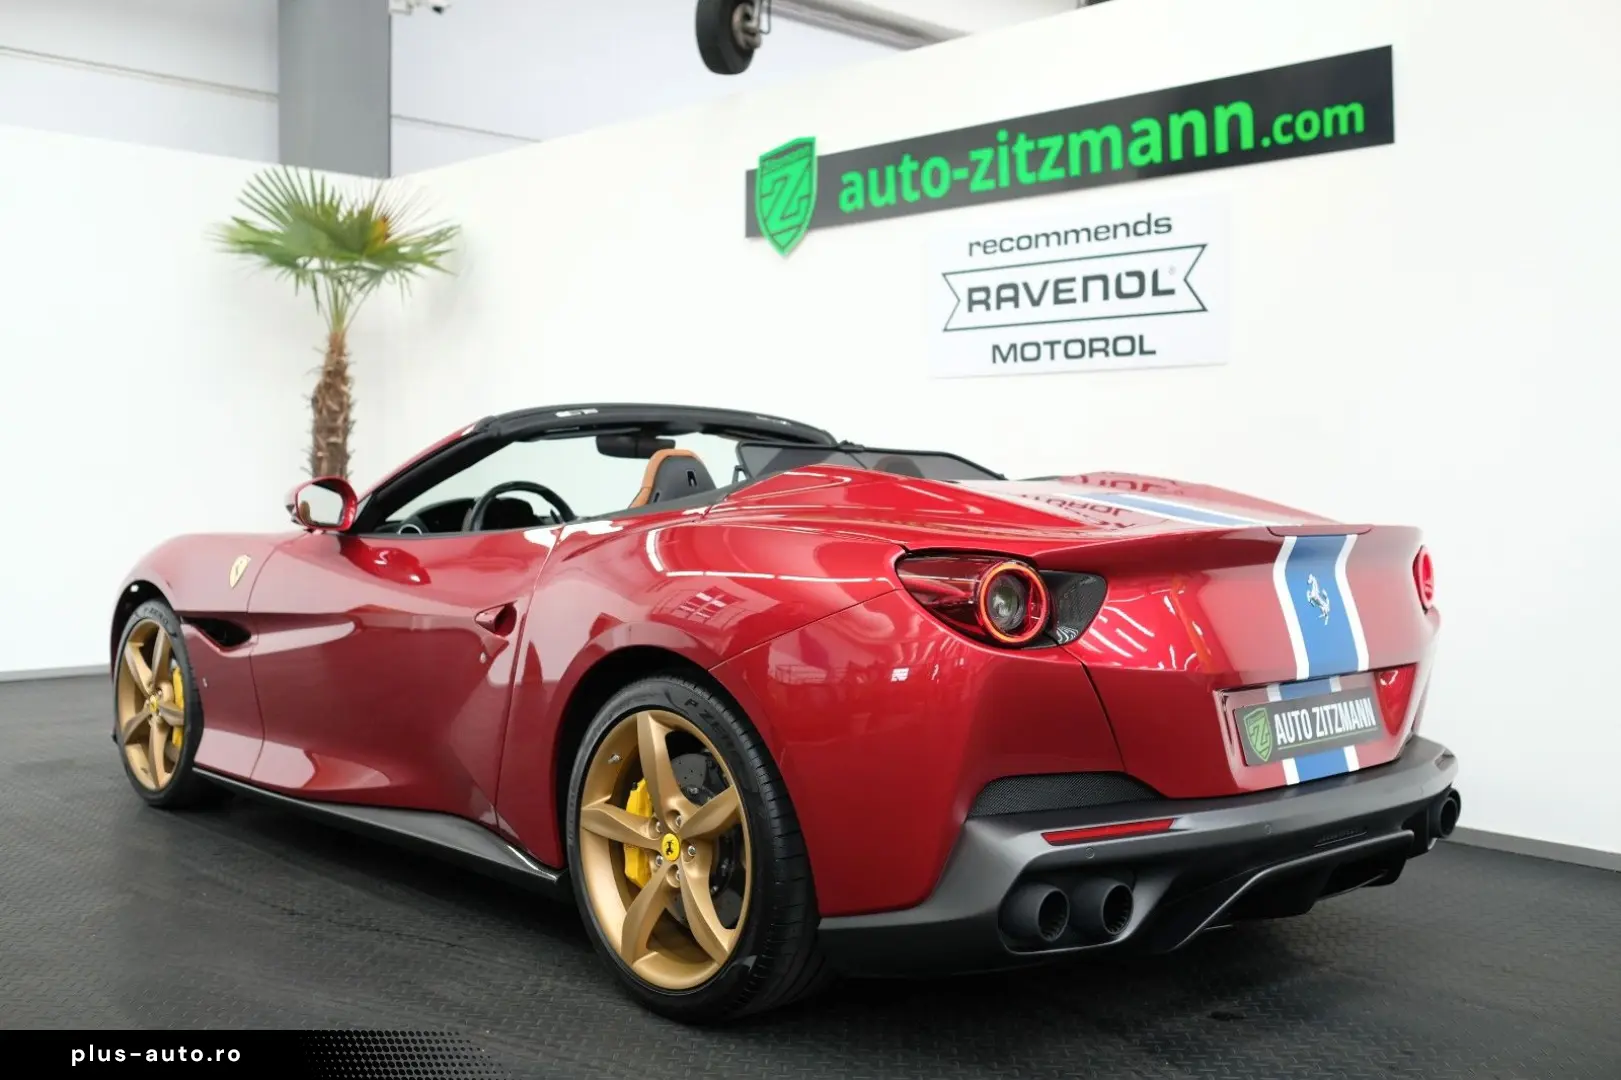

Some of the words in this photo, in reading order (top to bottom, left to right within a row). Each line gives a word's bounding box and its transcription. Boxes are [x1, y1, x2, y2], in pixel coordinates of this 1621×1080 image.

[837, 100, 1366, 213] auto-zitzmann.com
[968, 213, 1172, 257] recommends
[967, 269, 1176, 313] RAVENOL
[992, 335, 1157, 364] MOTOROL
[684, 698, 700, 708] P
[1274, 708, 1313, 746] AUTO
[1311, 697, 1377, 738] ZITZMANN
